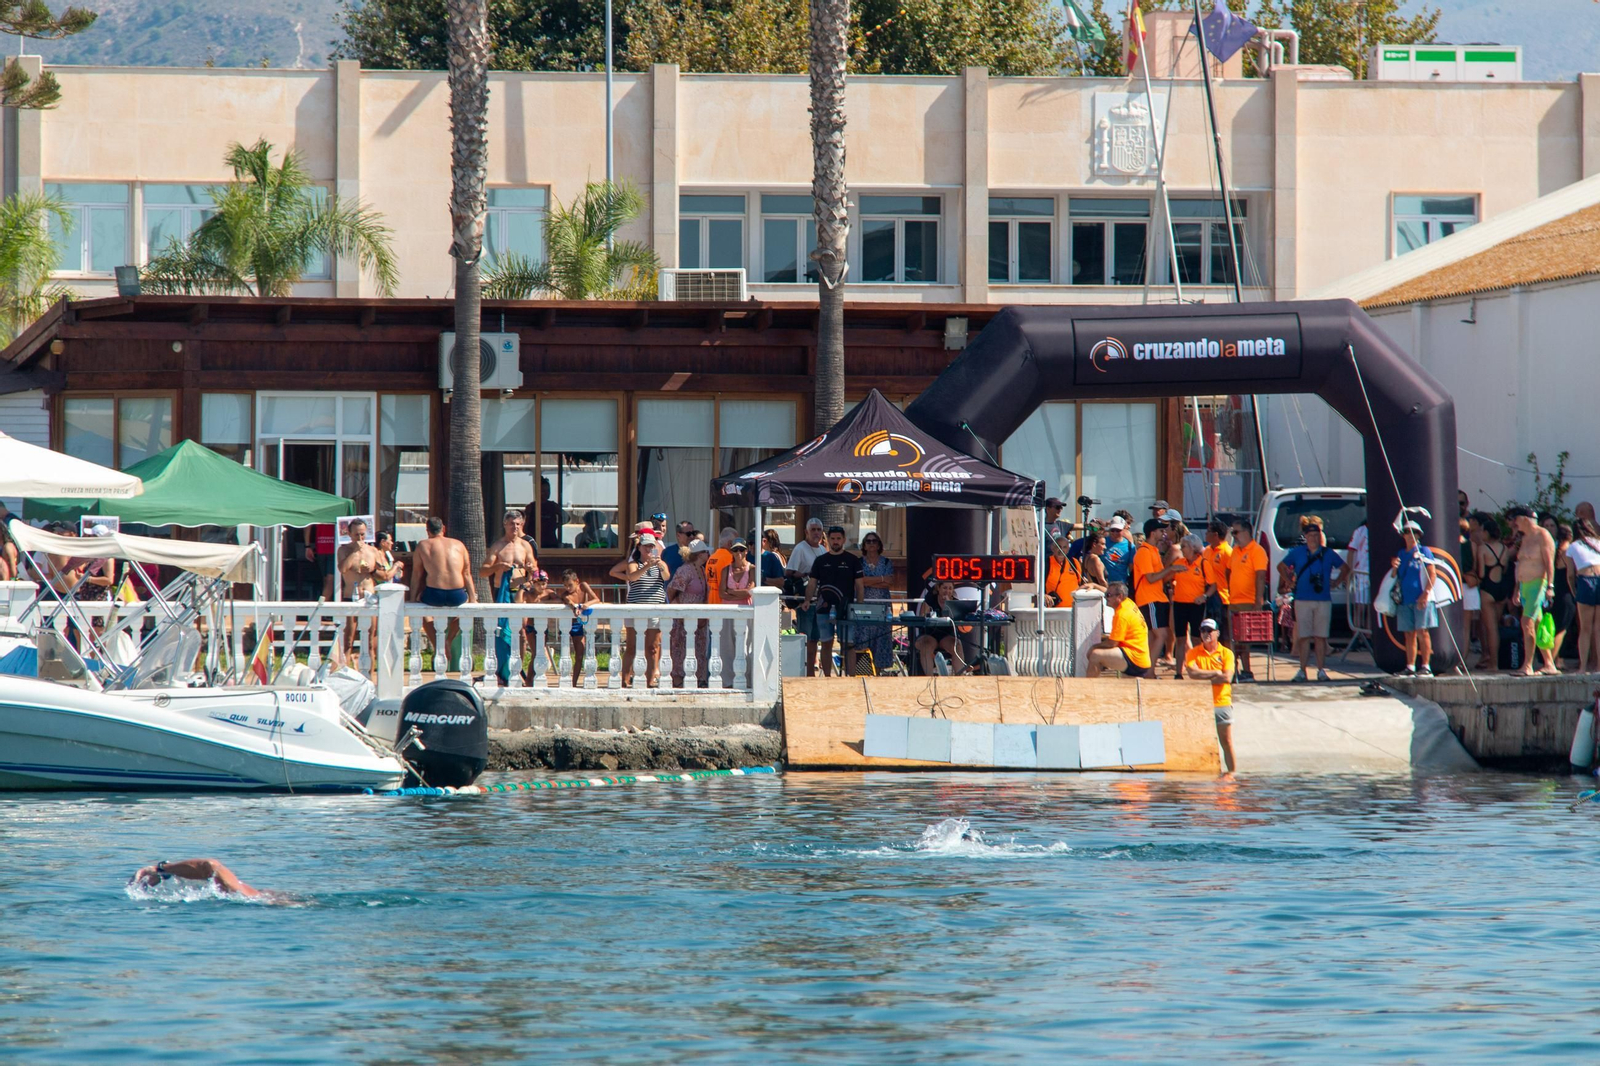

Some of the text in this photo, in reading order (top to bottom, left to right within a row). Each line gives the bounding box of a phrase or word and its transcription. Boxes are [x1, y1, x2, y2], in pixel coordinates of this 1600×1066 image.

[1133, 338, 1285, 360] cruzandolameta
[824, 470, 972, 479] cruzandolameta
[866, 480, 962, 492] cruzandolameta
[935, 557, 1030, 580] 00:51:07
[286, 693, 307, 703] ROCIO
[257, 717, 285, 728] SILVER
[404, 711, 476, 725] MERCURY
